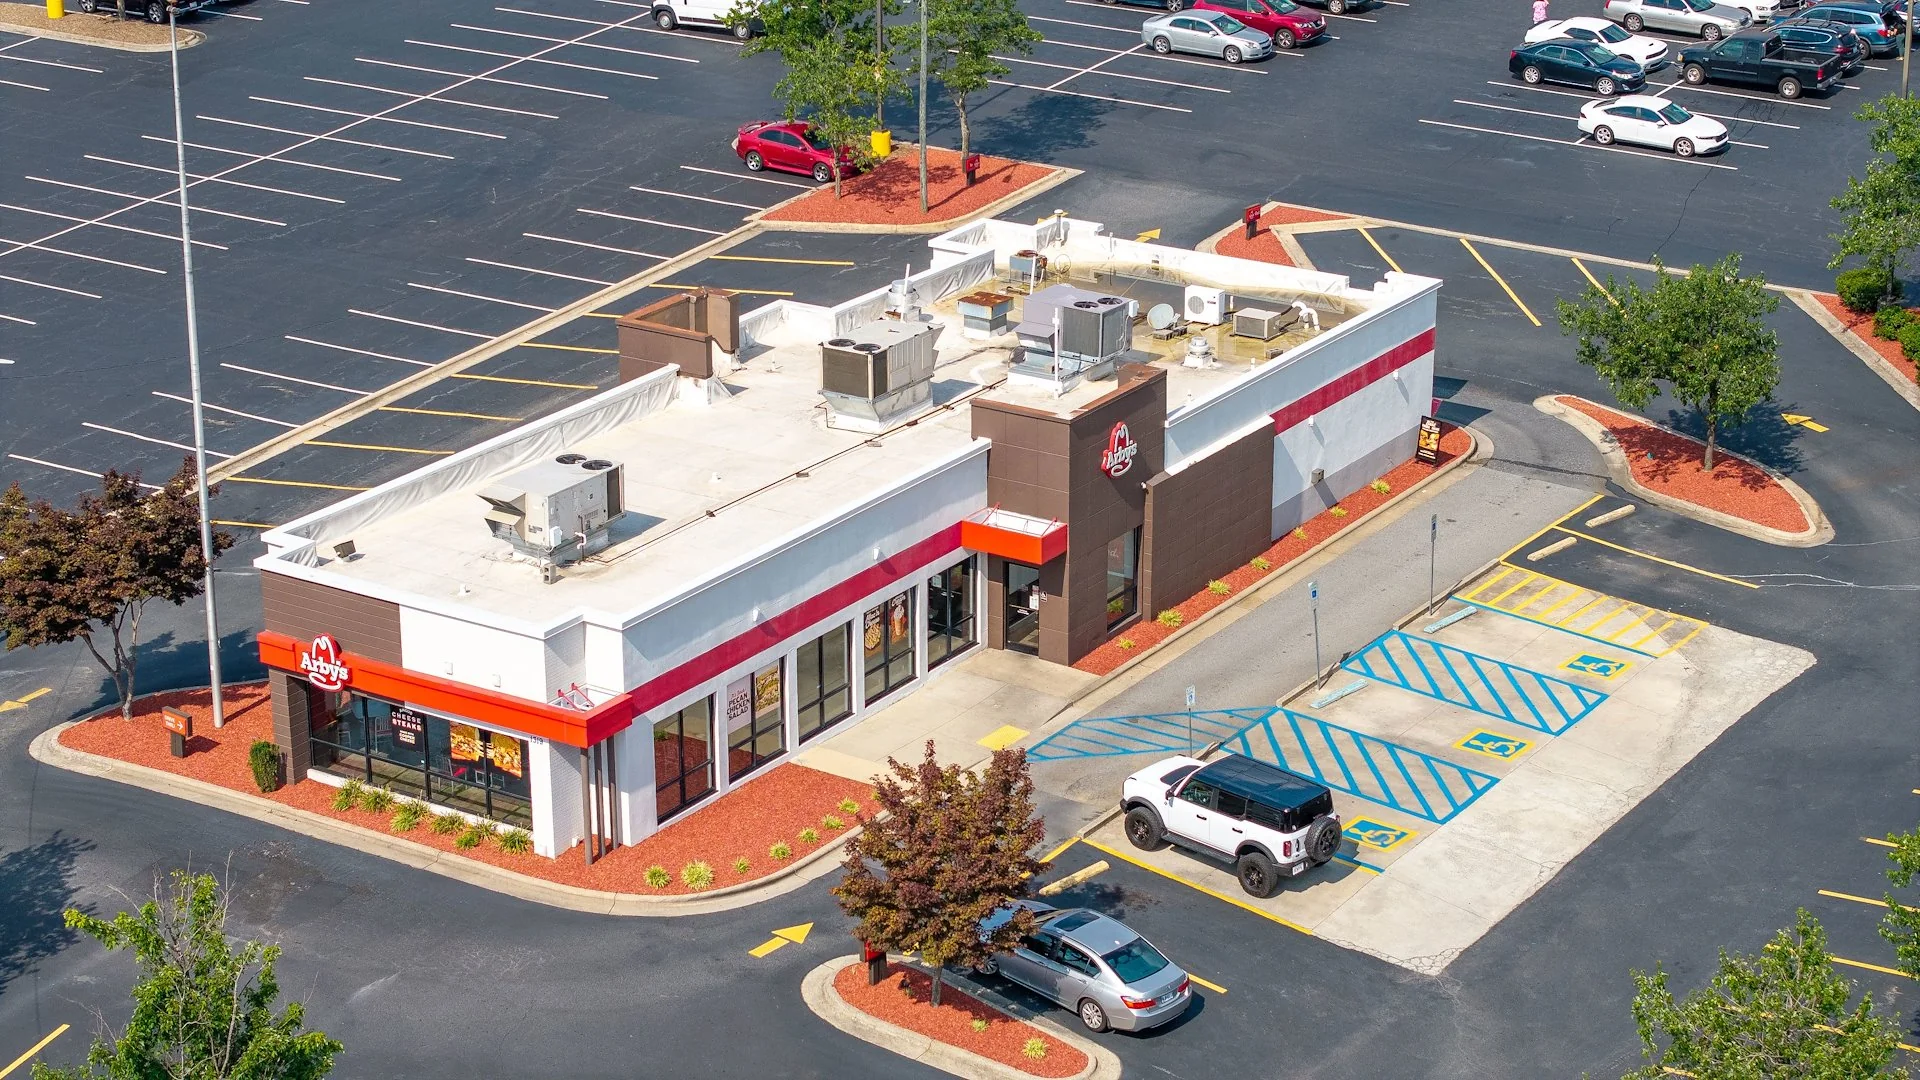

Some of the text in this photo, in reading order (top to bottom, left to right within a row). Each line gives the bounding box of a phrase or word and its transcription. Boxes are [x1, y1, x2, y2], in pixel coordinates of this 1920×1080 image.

[1106, 440, 1138, 470] Arby's
[300, 651, 349, 682] Arby's
[726, 698, 750, 715] CHICKEN
[728, 691, 748, 707] PECAN
[391, 711, 422, 724] CHEESE
[728, 706, 749, 721] SALAD
[392, 718, 422, 731] STEAKS
